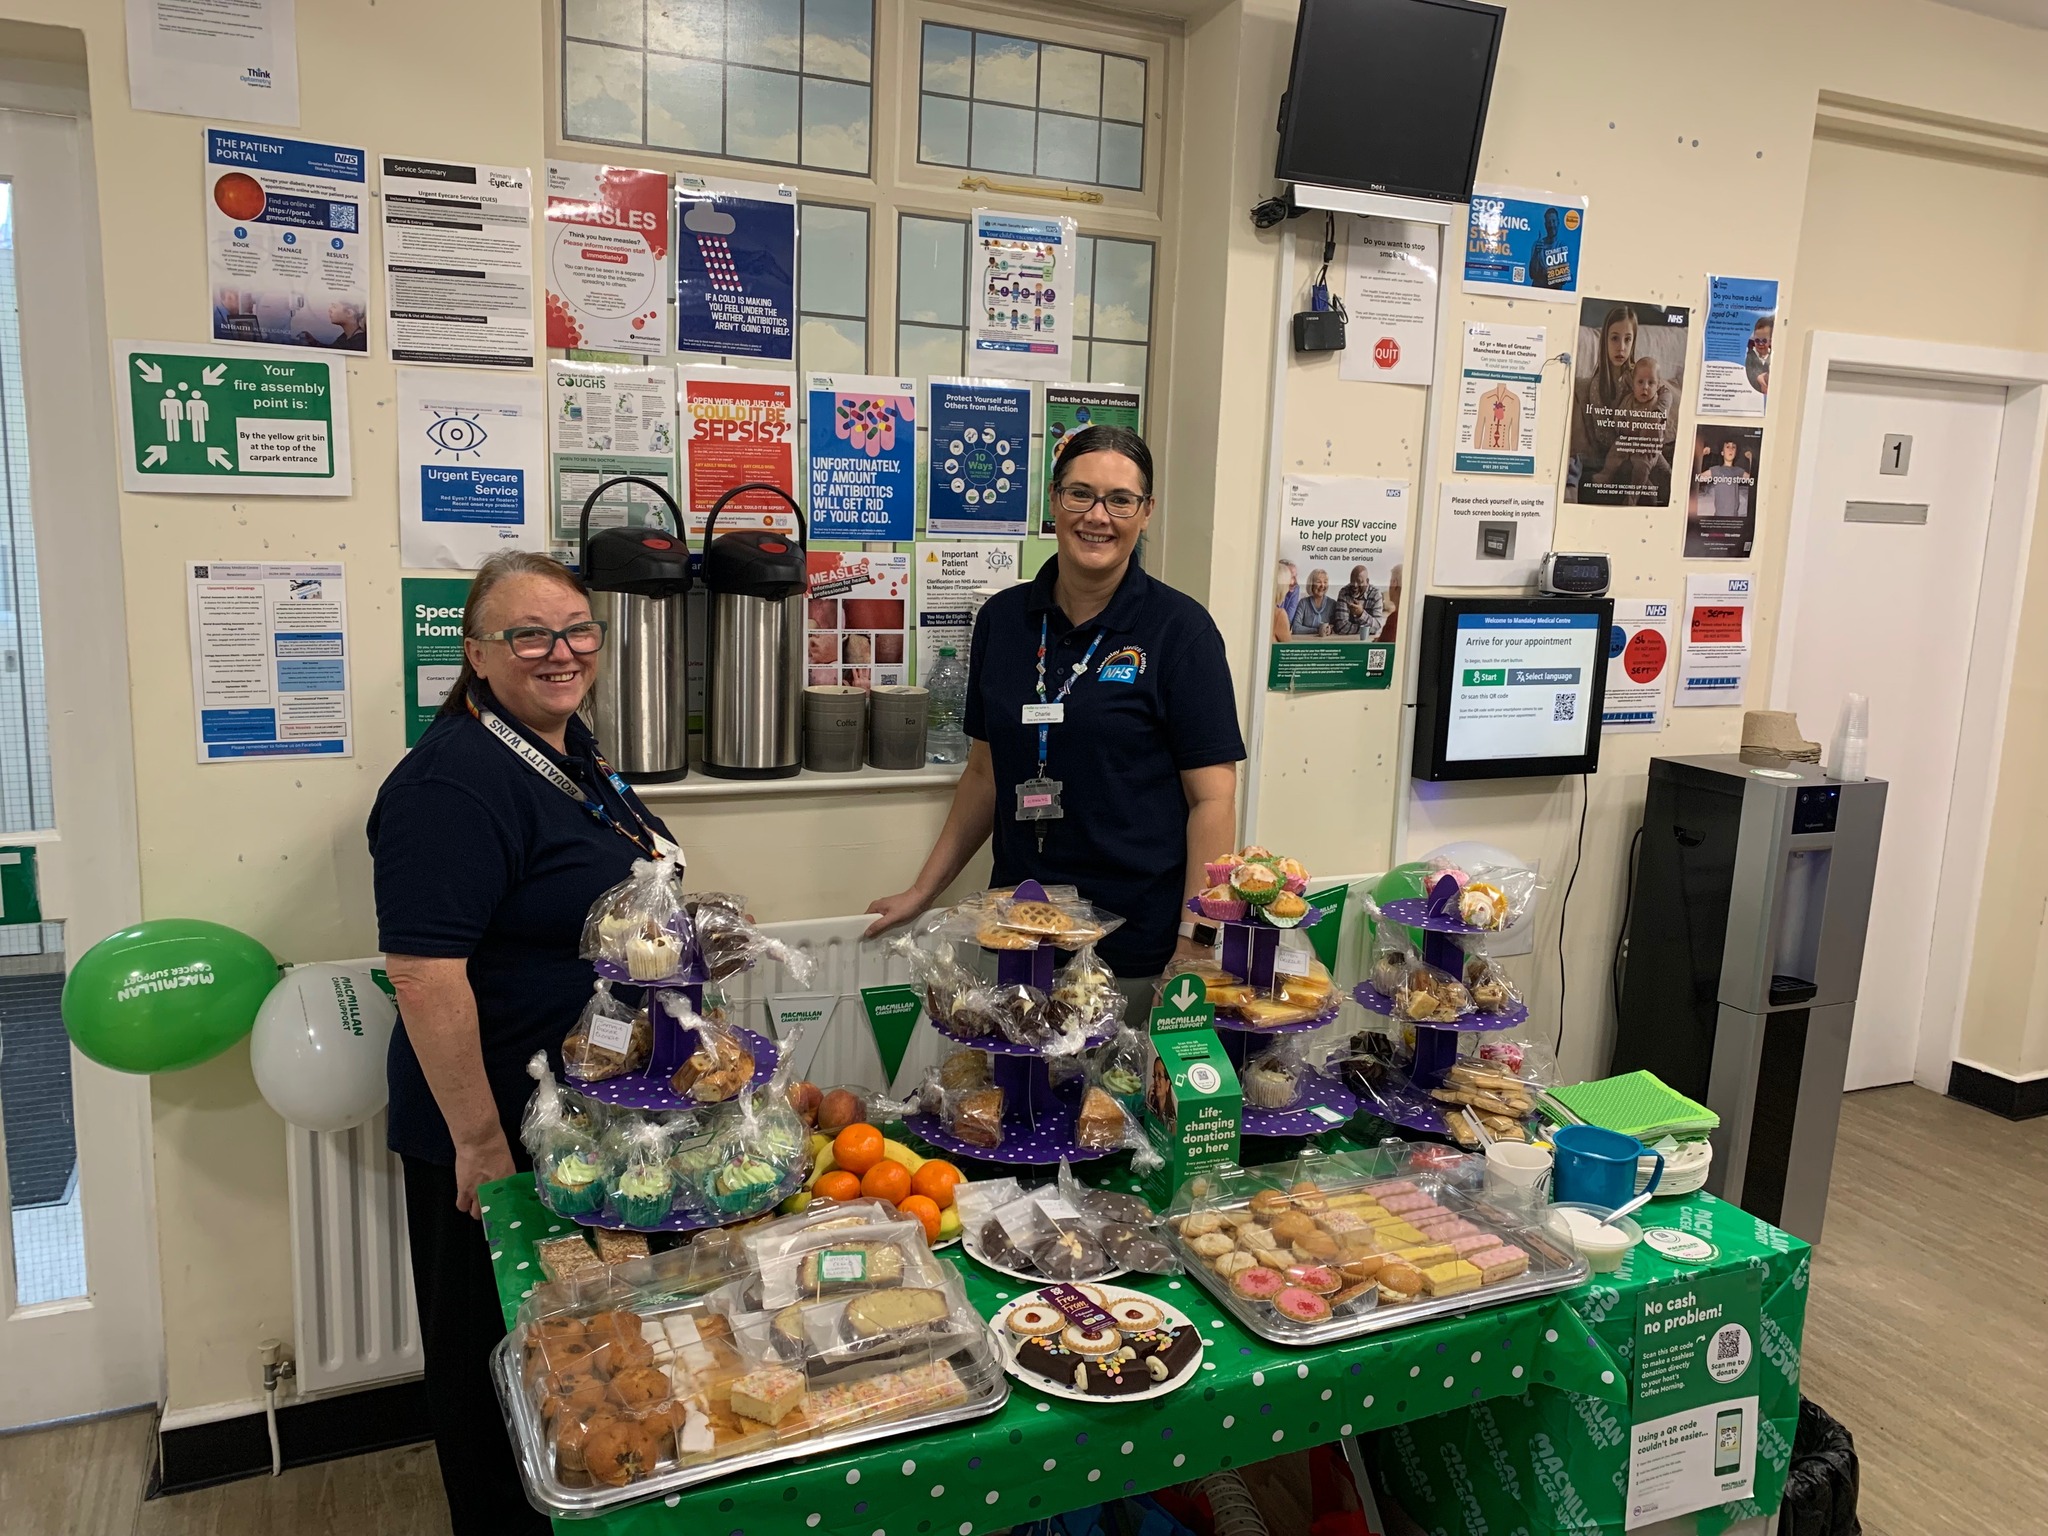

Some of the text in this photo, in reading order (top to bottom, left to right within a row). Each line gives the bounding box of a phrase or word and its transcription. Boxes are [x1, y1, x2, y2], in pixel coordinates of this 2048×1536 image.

[247, 68, 270, 78] Think
[216, 137, 284, 155] THE PATIENT
[216, 149, 258, 162] PORTAL
[394, 164, 447, 177] Service Summary
[586, 233, 597, 241] you
[613, 237, 640, 245] measles?
[1546, 251, 1568, 266] QUIT
[705, 293, 772, 307] IF A COLD IS MAKING
[709, 302, 777, 316] YOU FEEL UNDER THE
[712, 312, 787, 326] WEATHER, ANTIBIOTICS
[1667, 314, 1684, 324] NHS
[715, 322, 738, 331] AREN'T
[741, 325, 760, 333] GOING
[773, 328, 790, 336] HELP.
[1375, 347, 1398, 359] QUIT
[263, 364, 295, 377] Your
[234, 380, 325, 396] fire assembly
[557, 378, 606, 389] COUGHS
[253, 398, 308, 410] point is:
[946, 394, 972, 402] Protect
[974, 396, 1002, 404] Yourself
[1050, 395, 1070, 403] Break
[1082, 397, 1099, 405] Chain
[749, 407, 762, 422] IT
[766, 408, 785, 422] BE
[1586, 404, 1593, 414] If
[1614, 408, 1627, 416] not
[1629, 409, 1667, 419] vaccinated
[1631, 421, 1666, 431] protected
[240, 431, 250, 440] By
[252, 432, 266, 440] the
[268, 433, 294, 442] yellow
[297, 433, 311, 442] grit
[276, 444, 290, 452] top
[302, 444, 316, 452] the
[249, 454, 280, 463] carpark
[975, 453, 986, 461] 10
[1893, 442, 1902, 468] 1
[813, 457, 901, 473] UNFORTUNATELY,
[968, 461, 992, 471] Ways
[428, 469, 518, 483] Urgent Eyecare
[813, 470, 877, 484] NO AMOUNT
[1695, 474, 1754, 486] Keep going strong
[475, 485, 518, 496] Service
[813, 484, 893, 498] OF ANTIBIOTICS
[813, 497, 883, 510] WILL GET RID
[814, 510, 891, 523] OF YOUR COLD.
[1291, 517, 1397, 530] Have your RSV vaccine
[1299, 531, 1387, 544] to help protect you
[942, 551, 978, 559] Important
[809, 563, 868, 584] MEASLES
[1729, 580, 1748, 591] NHS
[415, 604, 465, 621] Specs
[1646, 605, 1667, 616] NHS
[416, 623, 463, 636] Home
[1466, 637, 1572, 648] Arrive for your appointment
[1102, 667, 1134, 679] NHS
[1482, 673, 1497, 681] Start
[1526, 672, 1572, 681] Select language
[836, 719, 857, 727] Coffee
[489, 720, 579, 796] EQUALITY WINS
[117, 972, 215, 1002] MACMILLAN
[340, 976, 364, 1037] MACMILLAN
[874, 1002, 914, 1012] MACMILLAN
[1157, 1015, 1207, 1026] MACMILLAN
[1199, 1107, 1222, 1118] Life-
[1185, 1118, 1234, 1131] changing
[1183, 1130, 1236, 1143] donations
[1188, 1143, 1229, 1157] go here
[1645, 1292, 1696, 1316] No cash
[1644, 1304, 1722, 1334] no problem!
